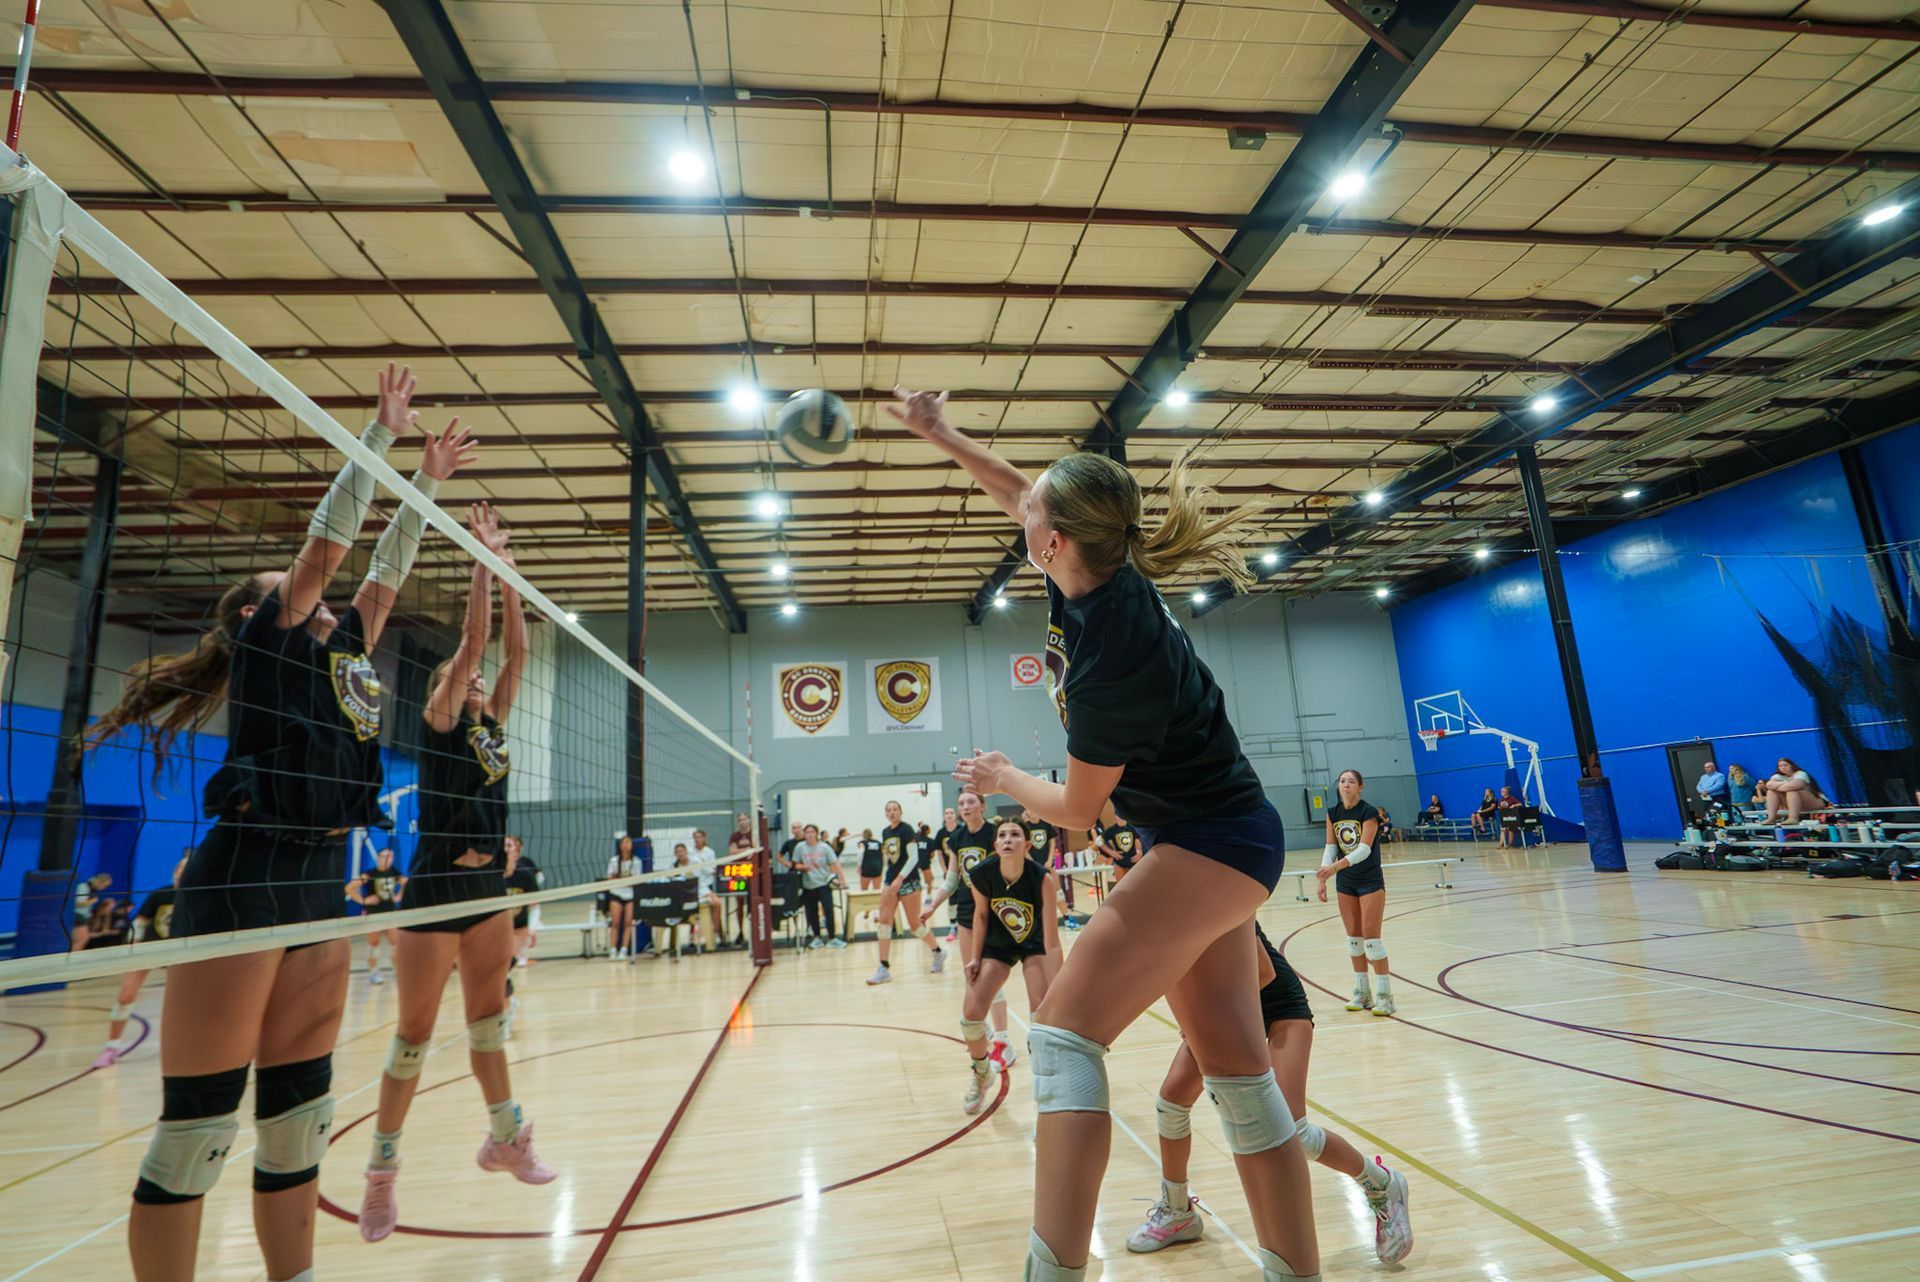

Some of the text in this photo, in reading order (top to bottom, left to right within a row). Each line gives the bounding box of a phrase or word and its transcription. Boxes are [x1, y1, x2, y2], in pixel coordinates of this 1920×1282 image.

[1049, 633, 1066, 651] DE
[802, 666, 832, 680] DENVER
[790, 708, 833, 722] BASKETBALL
